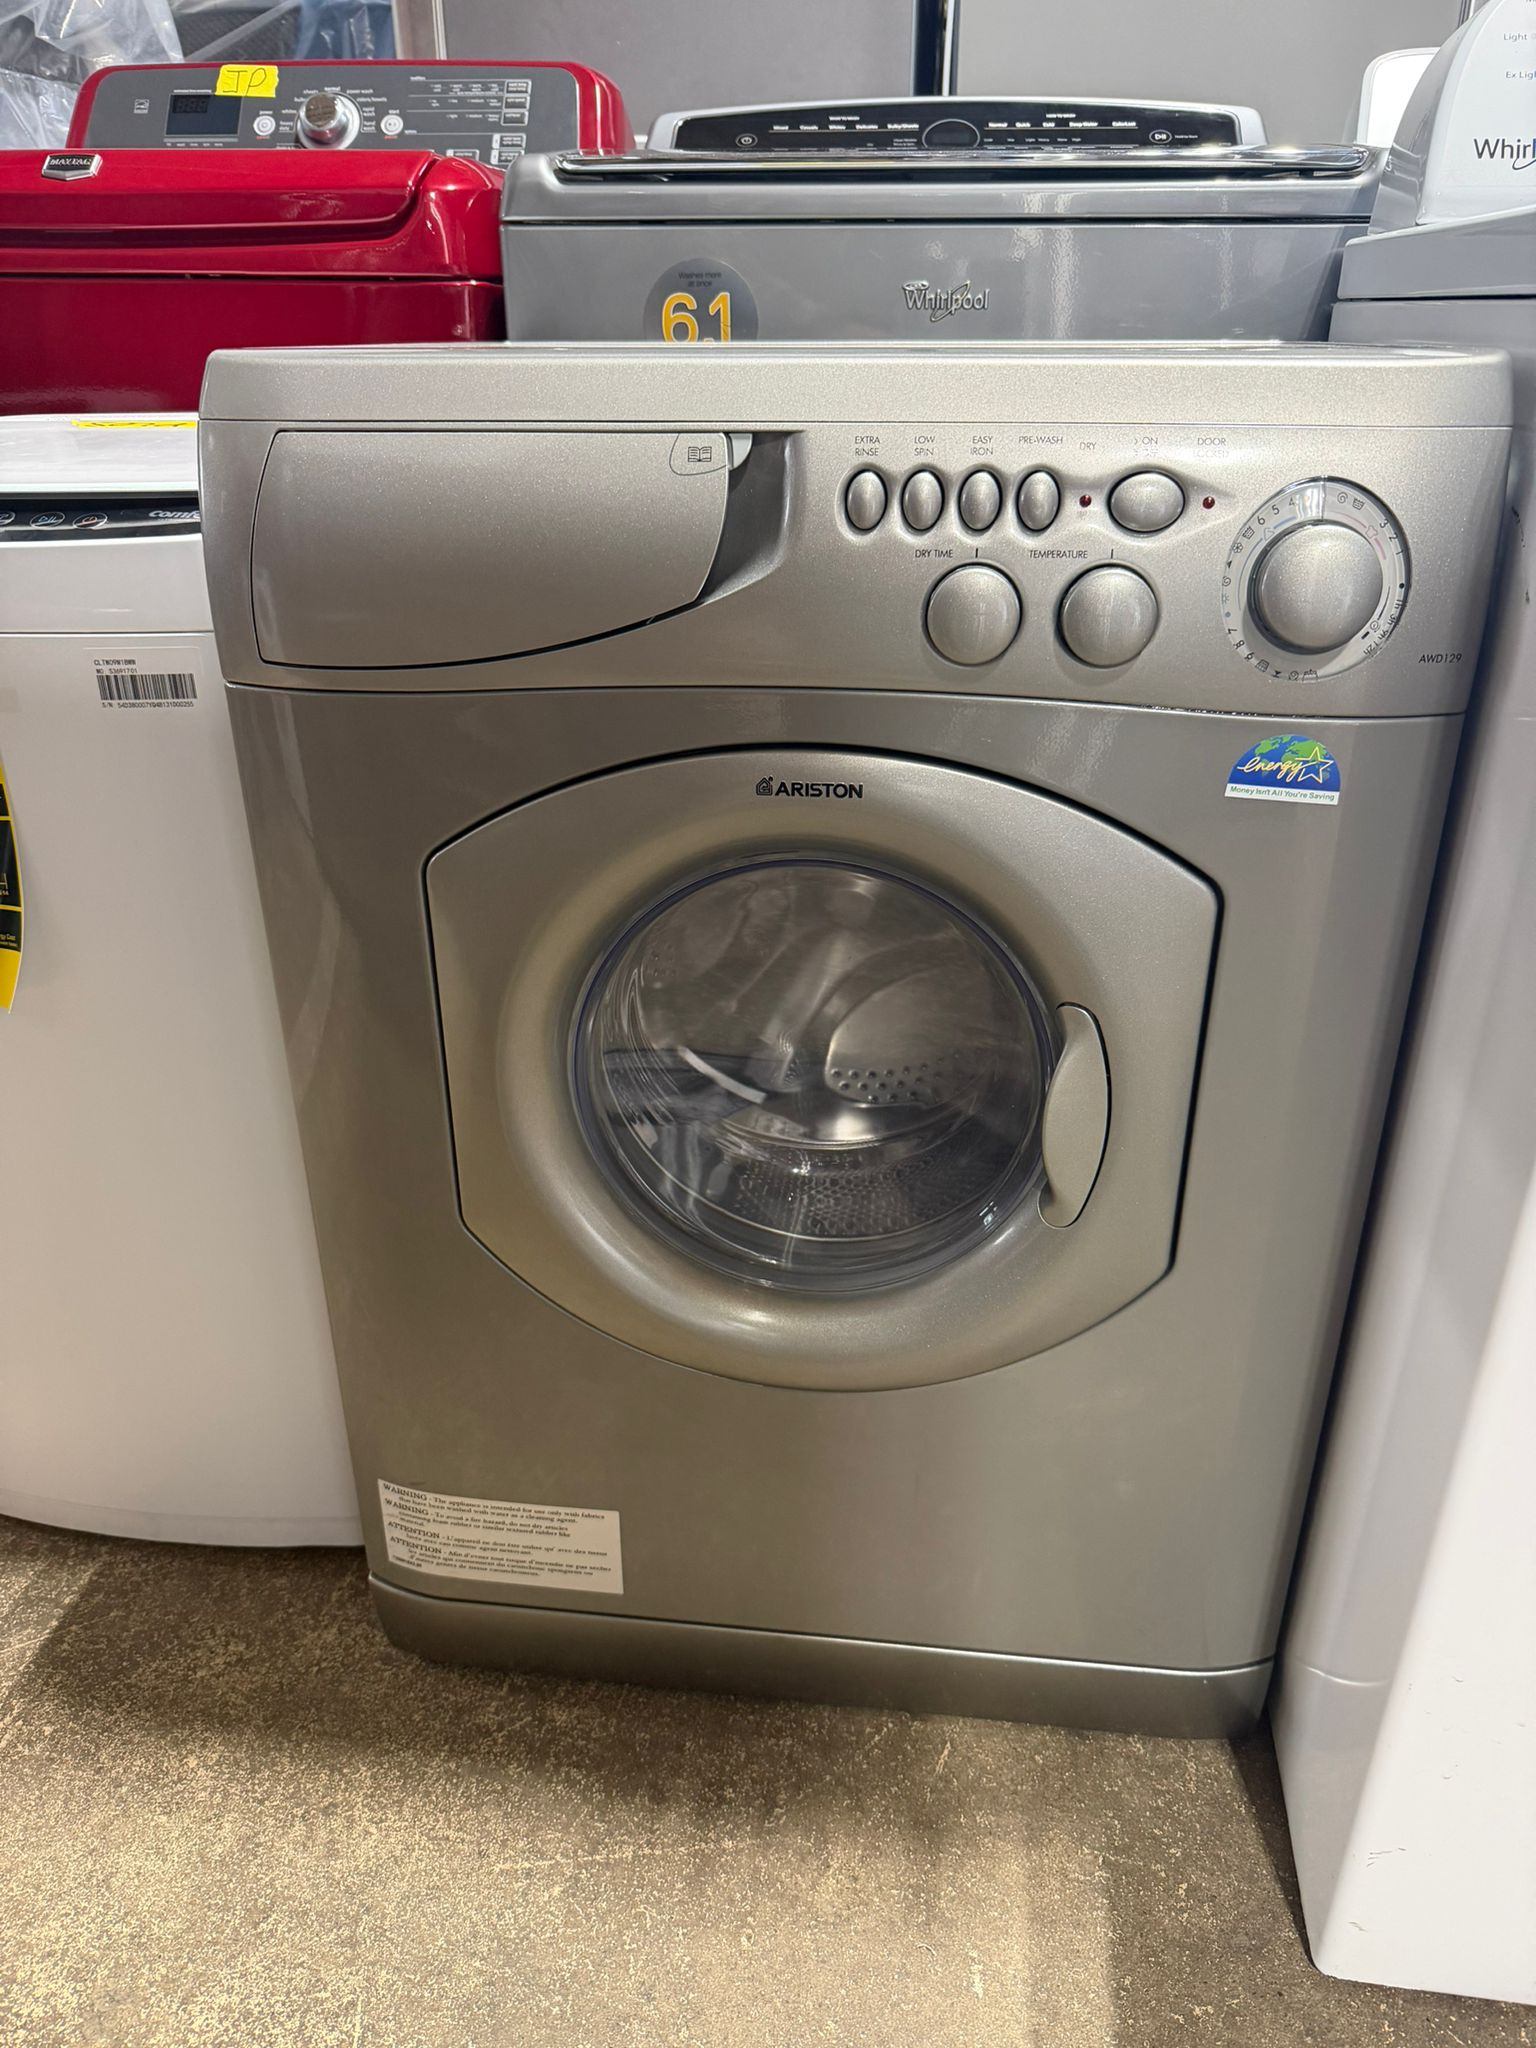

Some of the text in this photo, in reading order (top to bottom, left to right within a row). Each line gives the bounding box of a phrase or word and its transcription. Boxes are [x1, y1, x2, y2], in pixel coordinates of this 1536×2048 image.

[1503, 33, 1528, 42] Light
[1505, 71, 1517, 79] Ex
[904, 283, 990, 319] Whirlpool
[854, 436, 881, 444] EXTRA
[914, 436, 936, 444] LOW
[972, 436, 993, 444] EASY
[1018, 436, 1064, 444] PRE-WASH
[1197, 437, 1227, 446] DOOR
[1079, 442, 1097, 450] DRY
[854, 448, 879, 456] RINSE
[914, 448, 935, 456] SPIN
[971, 448, 994, 456] IRON
[1271, 504, 1280, 515] 5
[1257, 515, 1266, 525] 6
[1379, 518, 1389, 529] 3
[914, 549, 954, 558] DRY TIME
[1029, 550, 1089, 559] TEMPERATURE
[1418, 653, 1463, 664] AWD129
[1237, 756, 1303, 783] energy
[775, 781, 864, 799] ARISTON
[1230, 786, 1335, 801] Money Isn't All You're Saving
[383, 1483, 428, 1501] WARNING
[385, 1498, 429, 1516] WARNING
[388, 1521, 440, 1539] ATTENTION
[390, 1535, 442, 1554] ATTENTION
